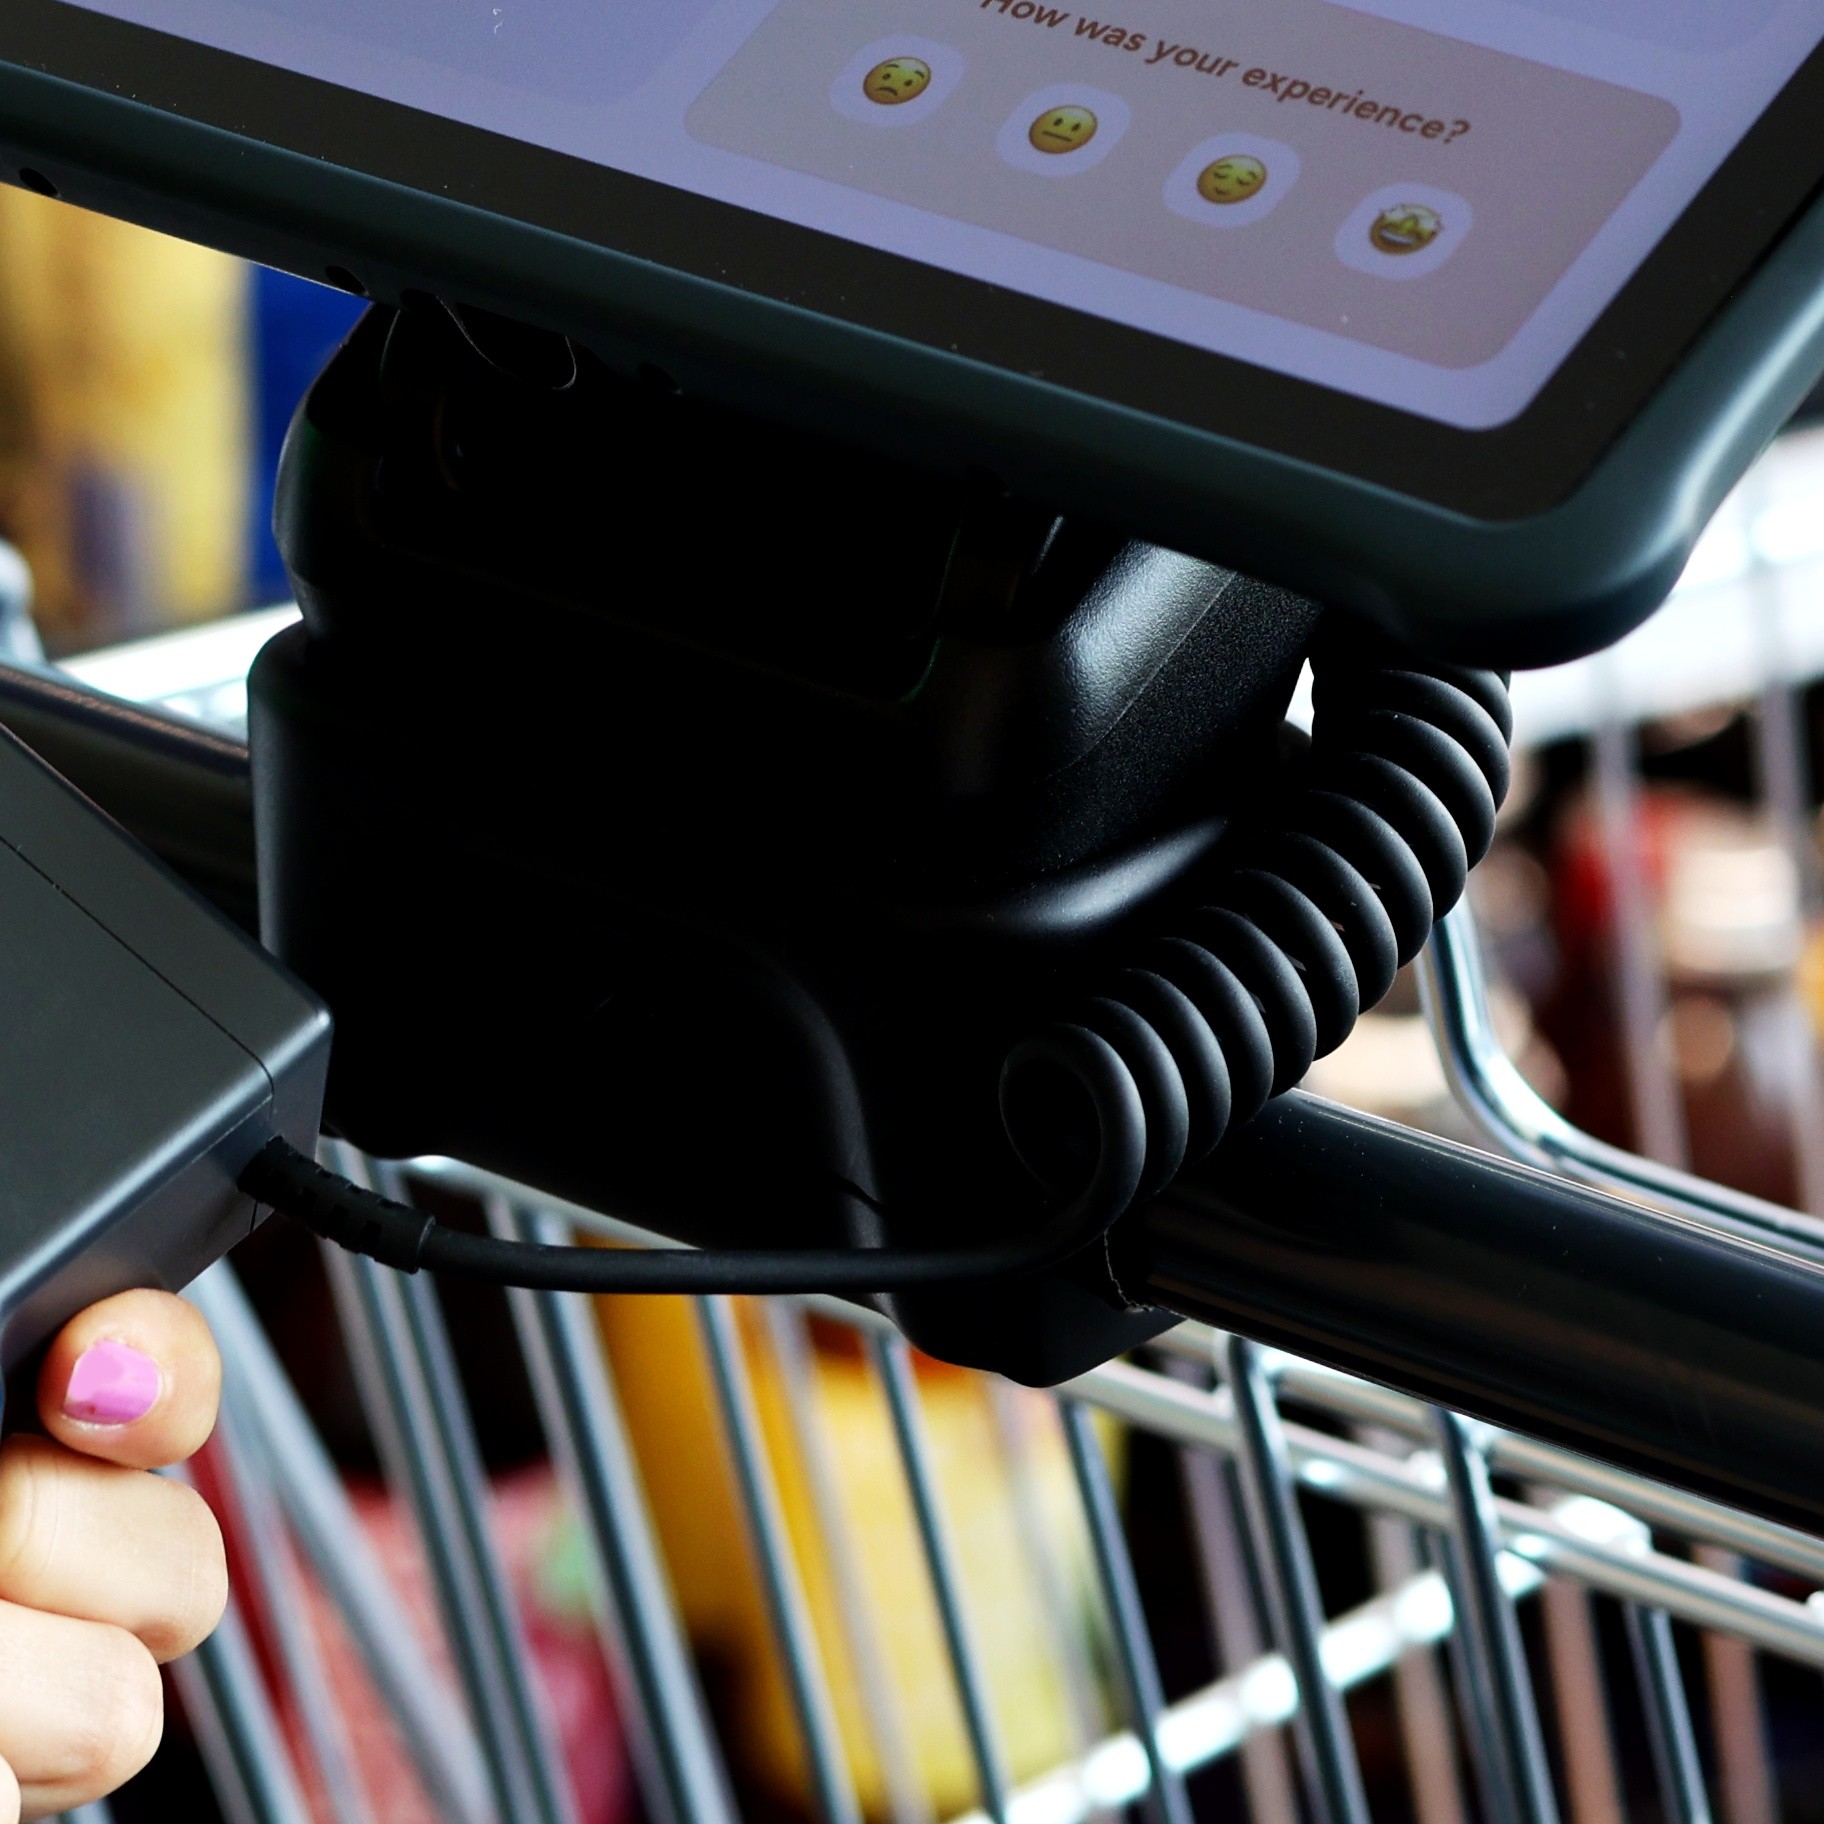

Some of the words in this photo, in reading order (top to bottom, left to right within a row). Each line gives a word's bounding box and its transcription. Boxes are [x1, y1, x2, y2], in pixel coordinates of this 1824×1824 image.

[1074, 15, 1147, 53] was
[1144, 38, 1239, 78] your
[1240, 65, 1472, 145] experience?
